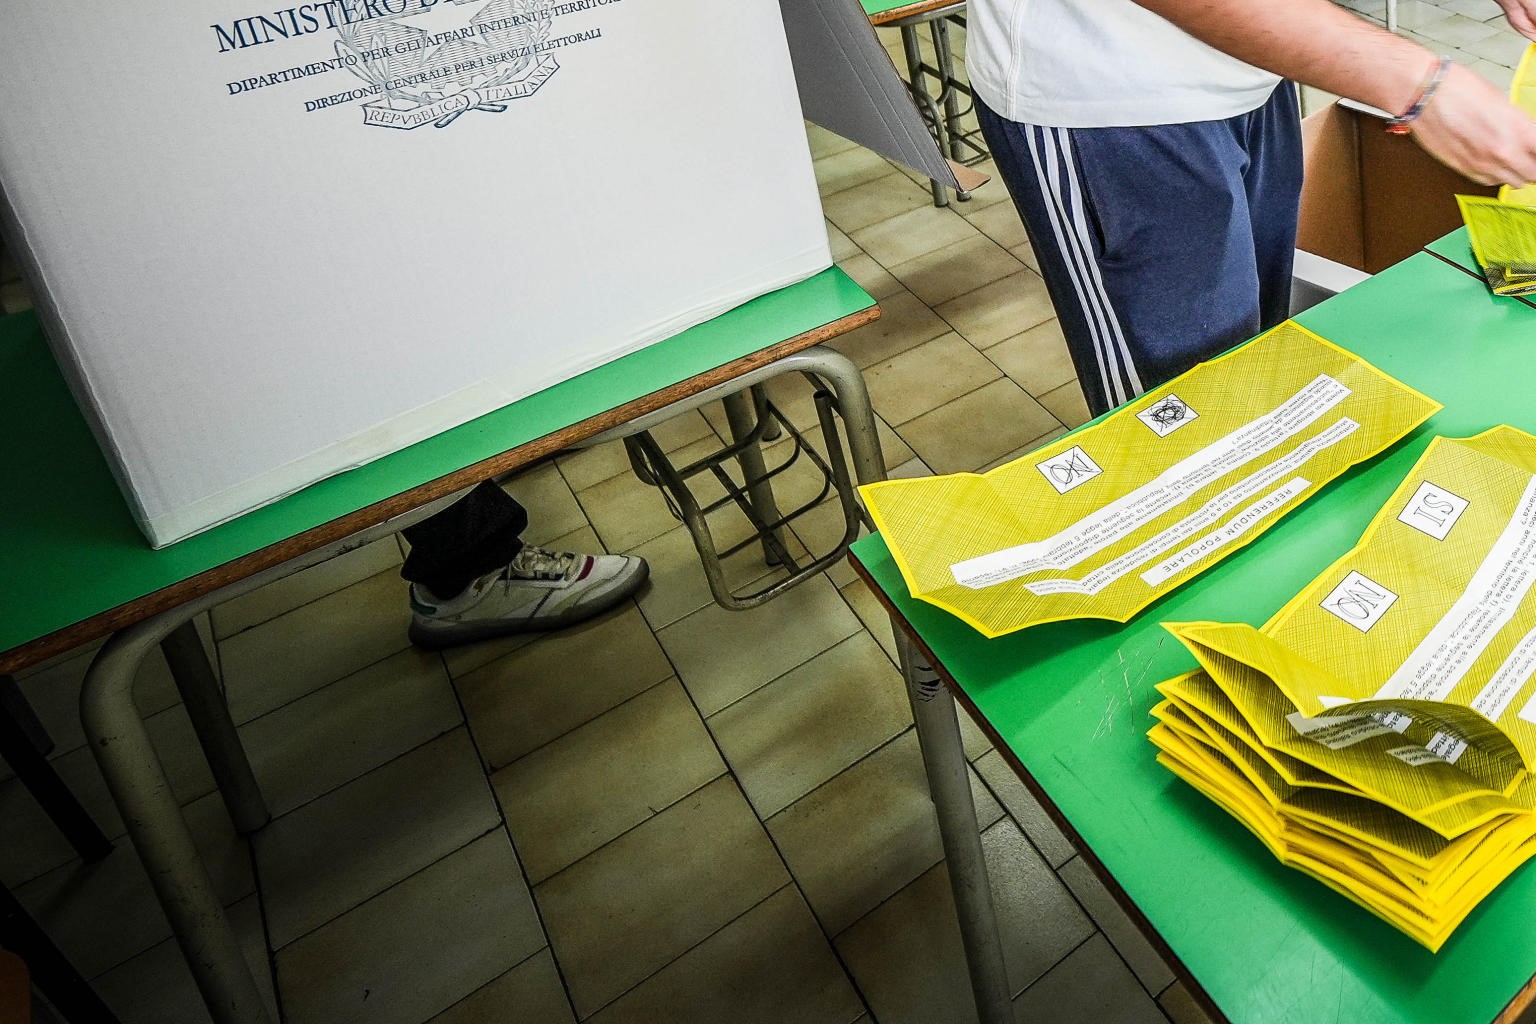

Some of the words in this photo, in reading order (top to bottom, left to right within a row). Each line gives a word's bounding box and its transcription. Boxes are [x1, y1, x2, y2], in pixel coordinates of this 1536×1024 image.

[226, 54, 358, 95] DIPARTIMENTO
[361, 43, 391, 63] PER
[422, 25, 476, 50] AFFARI
[478, 14, 538, 36] INTERNI
[538, 10, 549, 22] E
[304, 84, 383, 113] DIREZIONE
[385, 65, 453, 92] CENTRALE
[455, 59, 479, 75] PER
[486, 45, 532, 65] SERVIZI
[533, 27, 602, 54] ELETTORALI
[367, 97, 465, 127] REPVBBLICA
[485, 64, 556, 102] ITALIANA
[1047, 450, 1090, 489] NO
[1228, 460, 1283, 495] extracomunitario
[1243, 462, 1292, 494] Dimezzamento
[1208, 501, 1216, 509] la
[1215, 492, 1228, 503] per
[1222, 499, 1232, 508] 10
[1232, 492, 1242, 501] da
[1102, 510, 1121, 524] della
[1135, 507, 1144, 515] la
[1179, 507, 1209, 530] richiesta
[1224, 486, 1292, 537] REFERENDUM
[1413, 492, 1455, 528] SI
[1080, 521, 1102, 537] legge
[1194, 516, 1209, 528] anni
[1092, 529, 1117, 546] parole
[1124, 531, 1171, 561] concessione
[1157, 532, 1180, 549] tempi
[1517, 527, 1531, 546] anni
[1161, 532, 1221, 574] POPOLARE
[1509, 545, 1521, 559] nel
[1515, 536, 1536, 566] nonché
[1105, 558, 1124, 572] della
[1110, 551, 1149, 577] residenza
[1490, 558, 1513, 590] territorio
[1510, 564, 1519, 575] la
[1086, 573, 1110, 593] legale
[1494, 573, 1513, 599] lettera
[1509, 567, 1529, 593] lettera
[1336, 579, 1387, 620] NO
[1499, 592, 1512, 606] b),
[1467, 607, 1490, 634] recante
[1461, 632, 1470, 642] la
[1434, 639, 1464, 673] seguente
[1453, 649, 1469, 666] alle
[1515, 655, 1535, 677] tempi
[1413, 658, 1434, 681] legge
[1433, 663, 1456, 689] parole
[1483, 654, 1521, 700] concessione
[1408, 679, 1418, 688] 5
[1507, 676, 1518, 687] di
